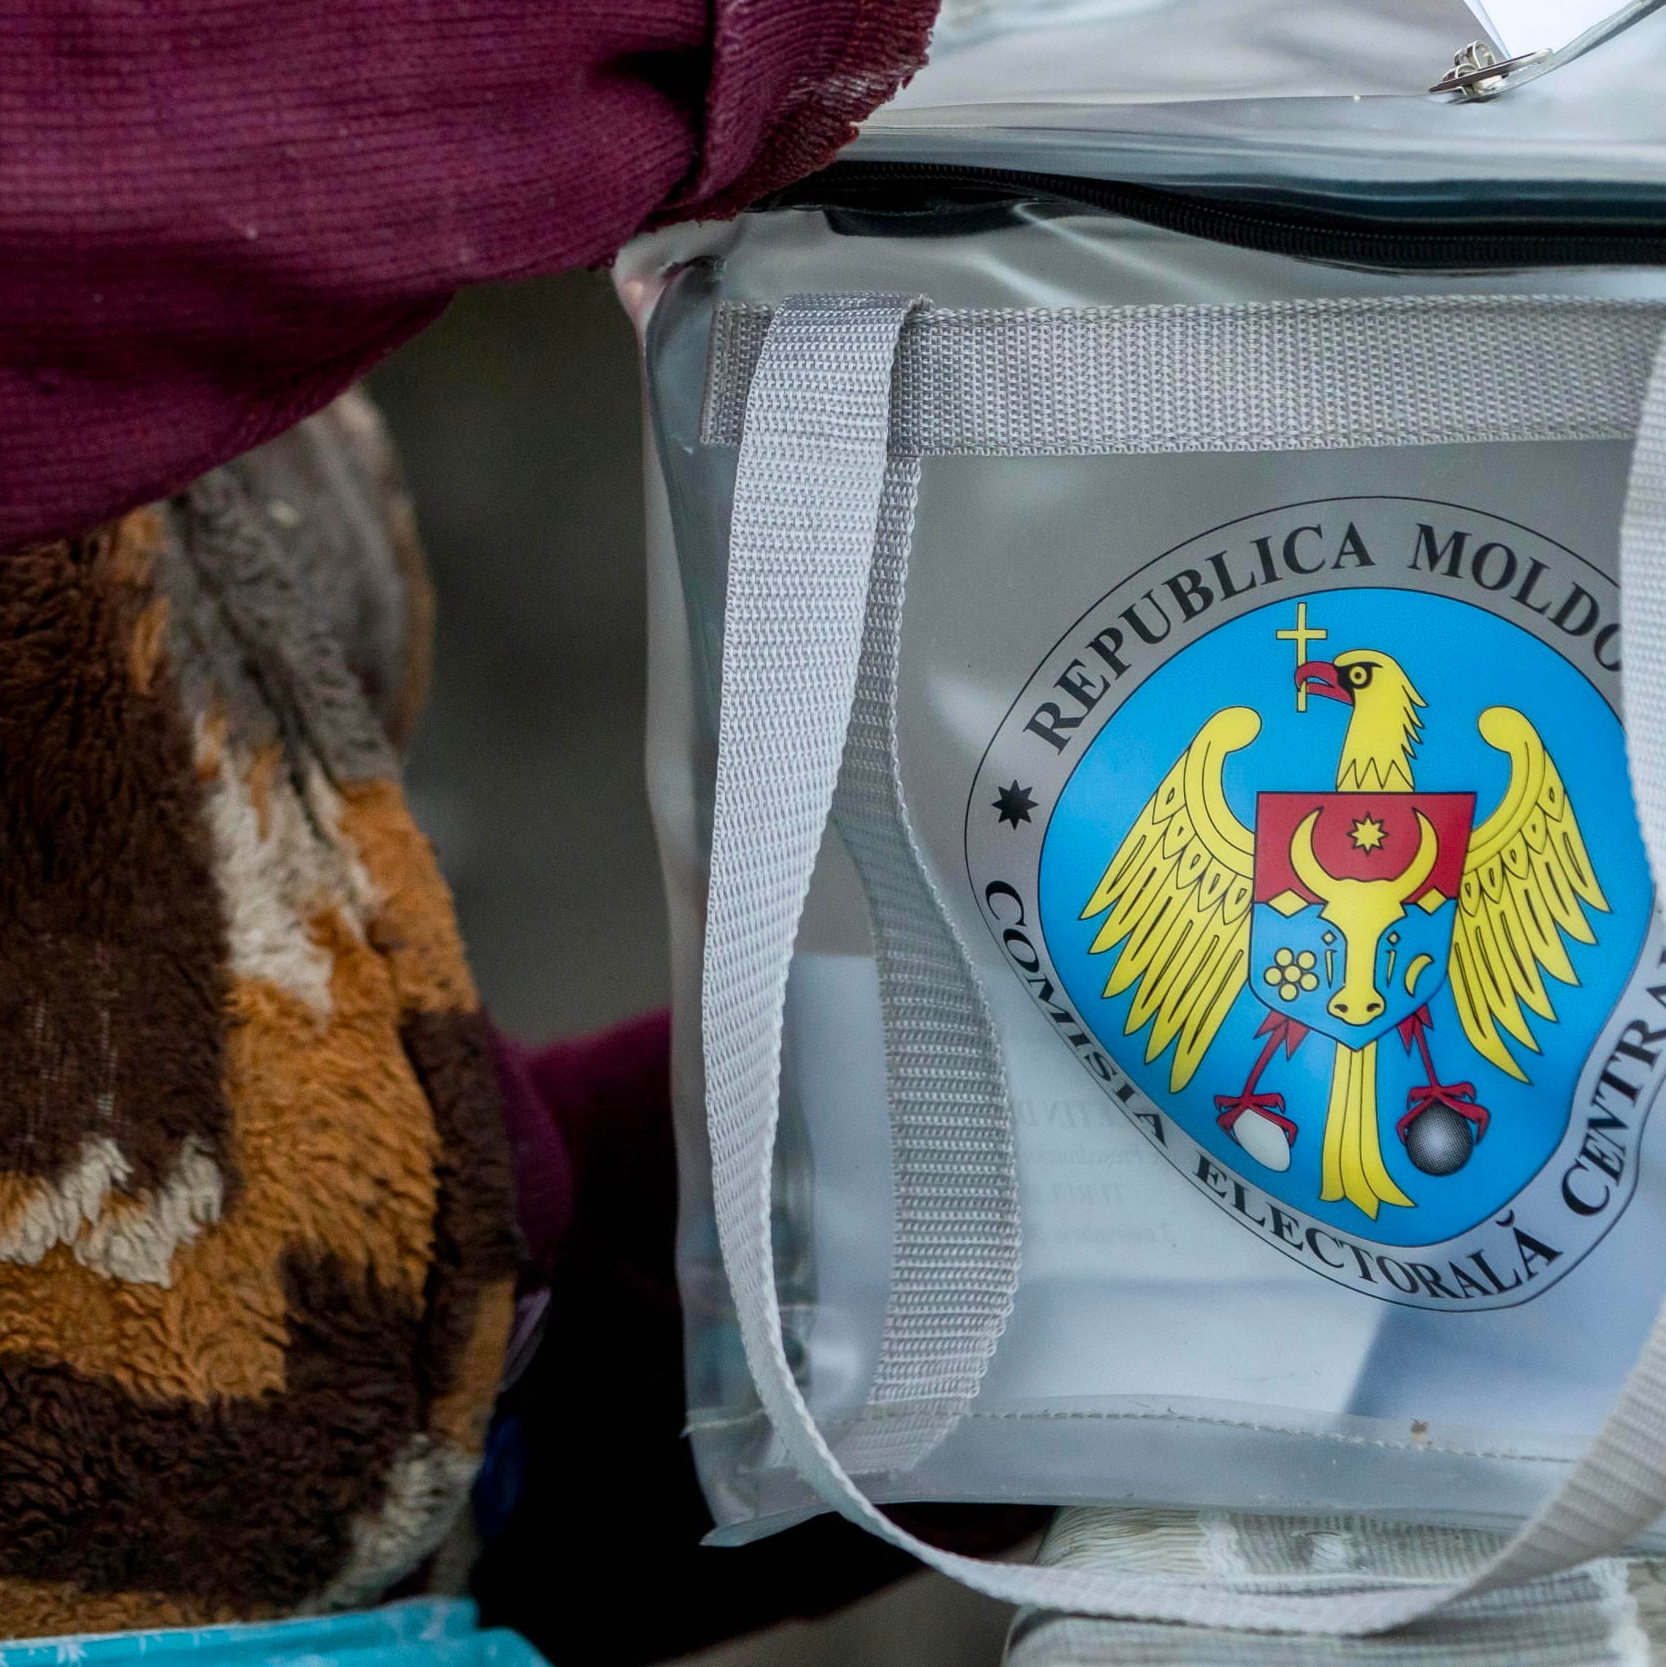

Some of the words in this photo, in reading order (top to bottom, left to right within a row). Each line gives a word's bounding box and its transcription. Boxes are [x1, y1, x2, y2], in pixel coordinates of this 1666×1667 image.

[1023, 521, 1378, 756] REPUBLICA
[1411, 521, 1621, 672] MOLDO
[984, 878, 1169, 1149] COMISIA
[1192, 1149, 1563, 1301] ELECTORALĂ
